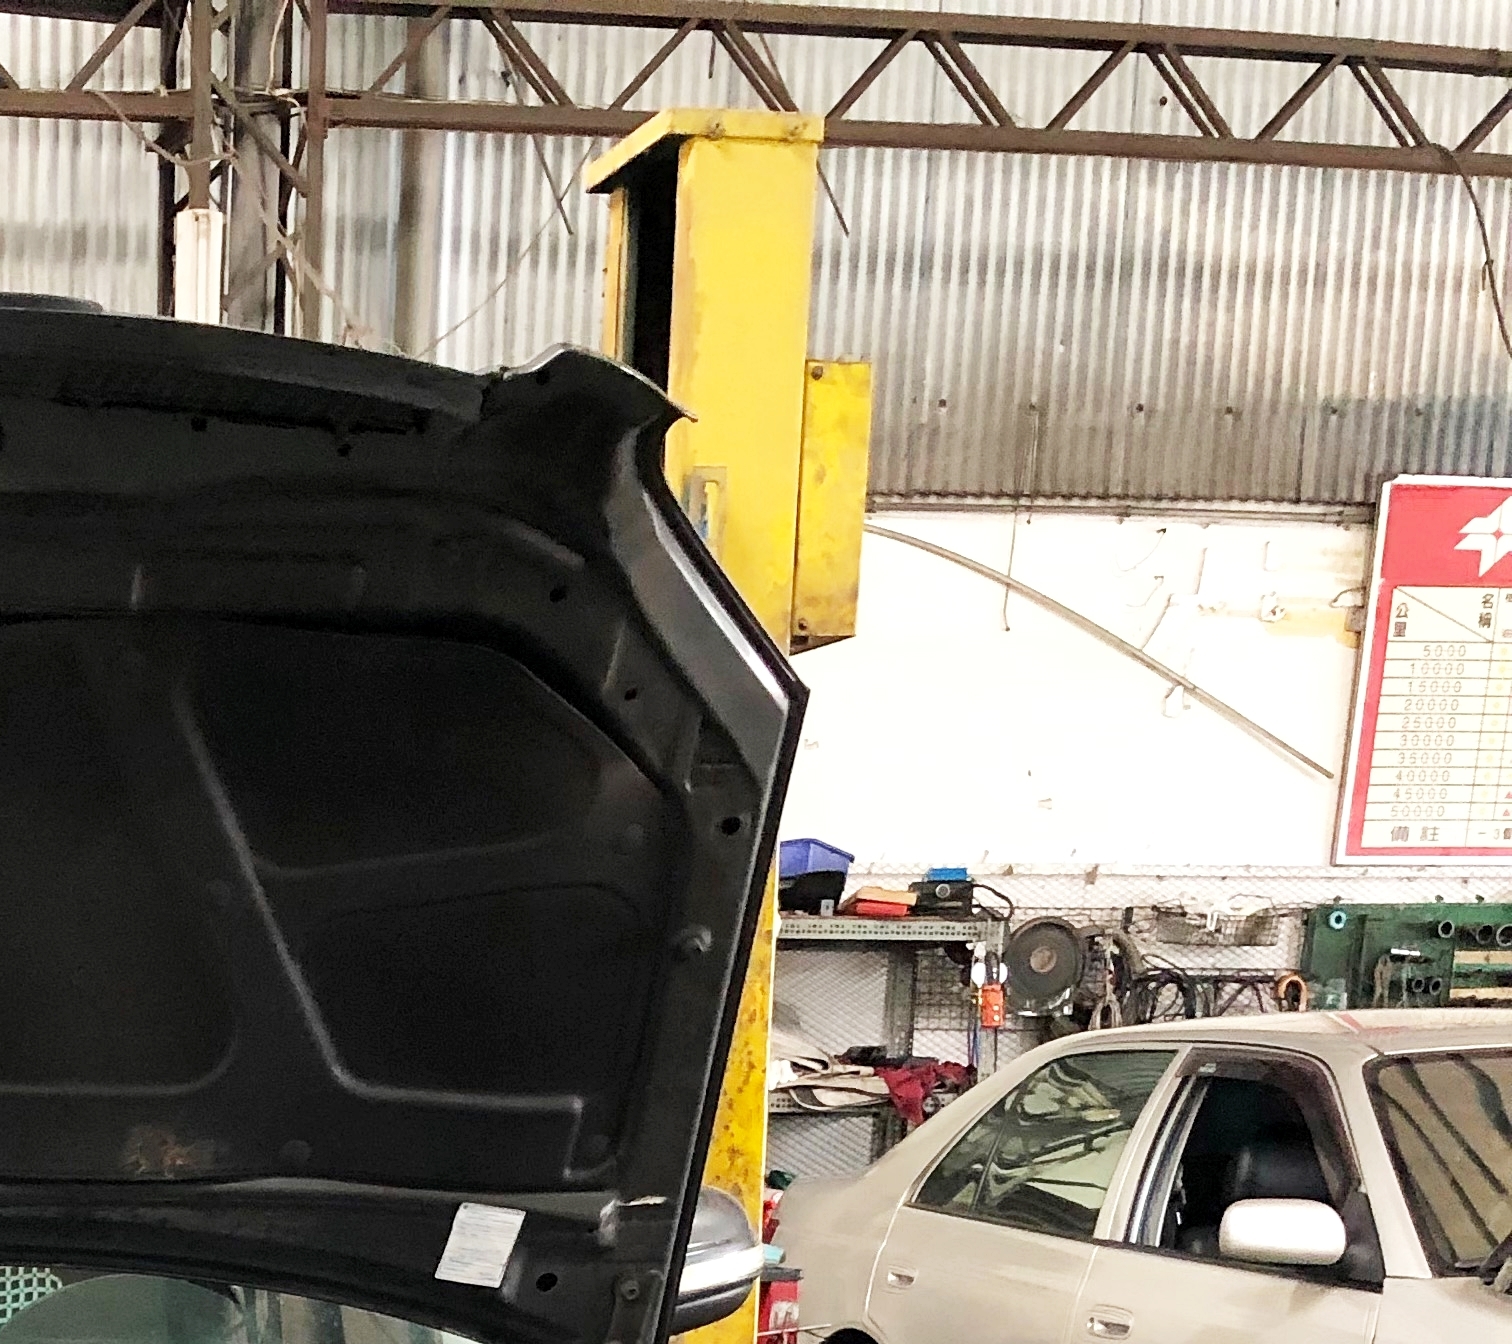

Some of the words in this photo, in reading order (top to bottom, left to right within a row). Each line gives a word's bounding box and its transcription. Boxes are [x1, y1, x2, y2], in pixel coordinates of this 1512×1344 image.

[1393, 602, 1409, 637] 公里
[1423, 645, 1466, 657] 5000
[1410, 662, 1465, 675] 10000
[1408, 680, 1462, 693] 15000
[1404, 698, 1459, 711] 20000
[1402, 716, 1457, 729] 25000
[1400, 734, 1455, 747] 30000
[1398, 752, 1452, 765] 35000
[1395, 770, 1450, 783] 40000
[1394, 788, 1448, 800] 45000
[1390, 805, 1445, 818] 50000
